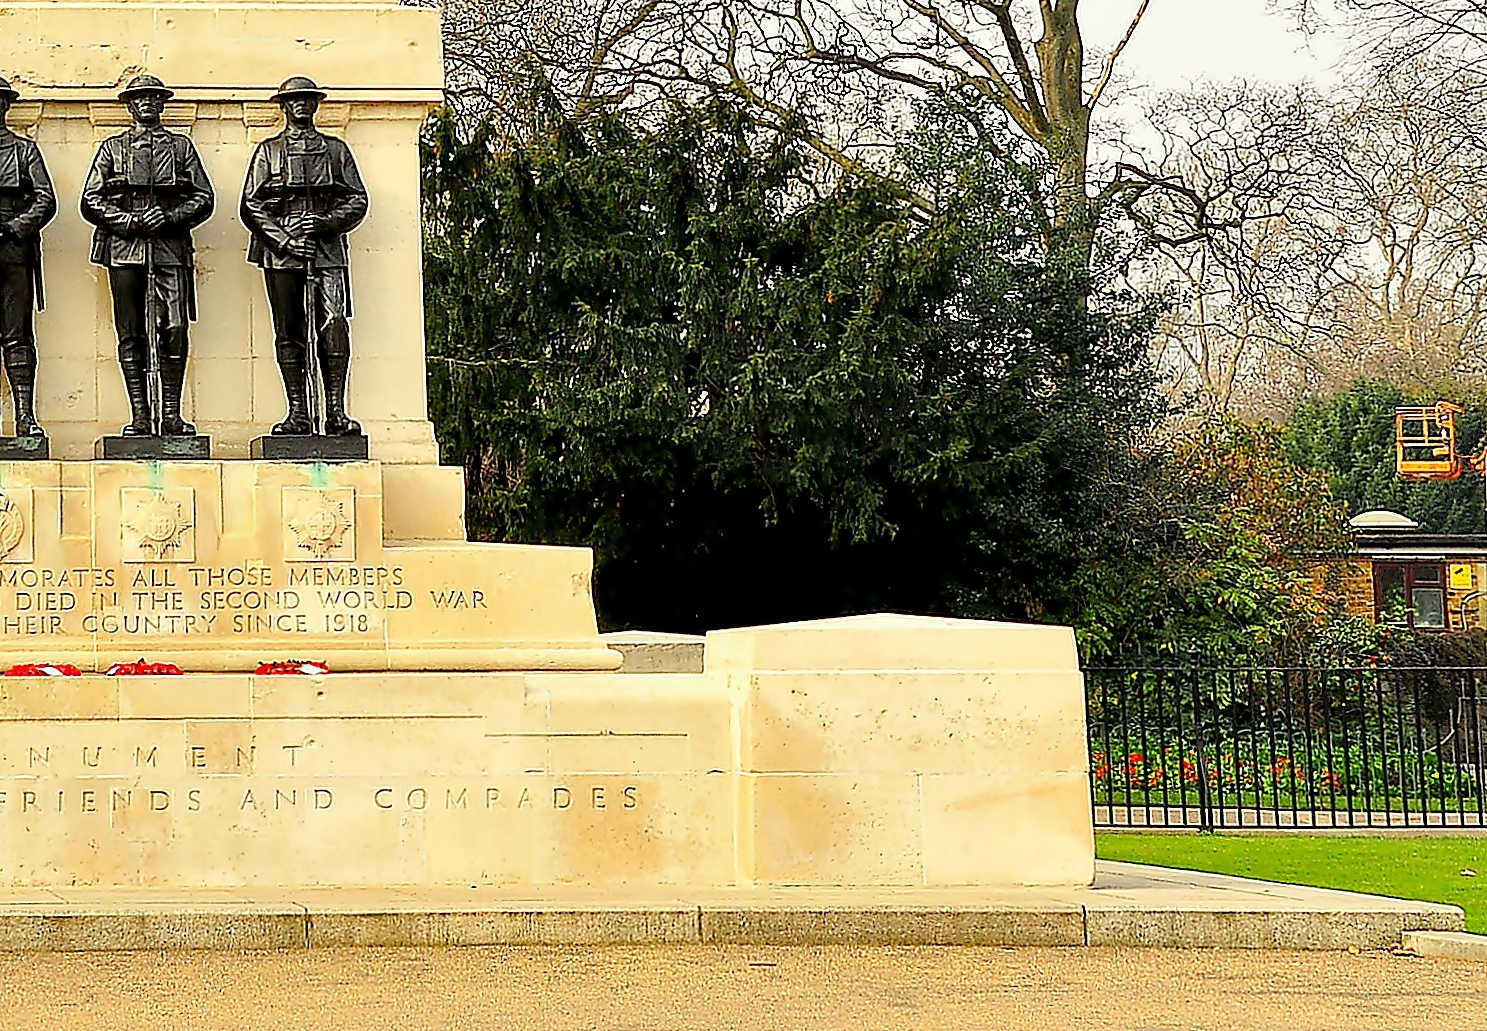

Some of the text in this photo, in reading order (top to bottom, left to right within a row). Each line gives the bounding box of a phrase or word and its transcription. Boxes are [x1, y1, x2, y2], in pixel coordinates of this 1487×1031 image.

[132, 568, 175, 588] ALL
[188, 568, 272, 588] THOSE
[286, 567, 403, 587] MEMBERS
[15, 592, 76, 612] DIED
[92, 591, 118, 611] IN
[132, 591, 183, 611] THE
[199, 591, 299, 611] SECOND
[317, 591, 413, 610] WORLD
[429, 590, 488, 610] WAR
[81, 614, 217, 635] COUNTRY
[232, 613, 307, 634] SINCE
[324, 614, 369, 633] 1918
[240, 787, 335, 811] AND
[373, 786, 639, 810] COMRADES
